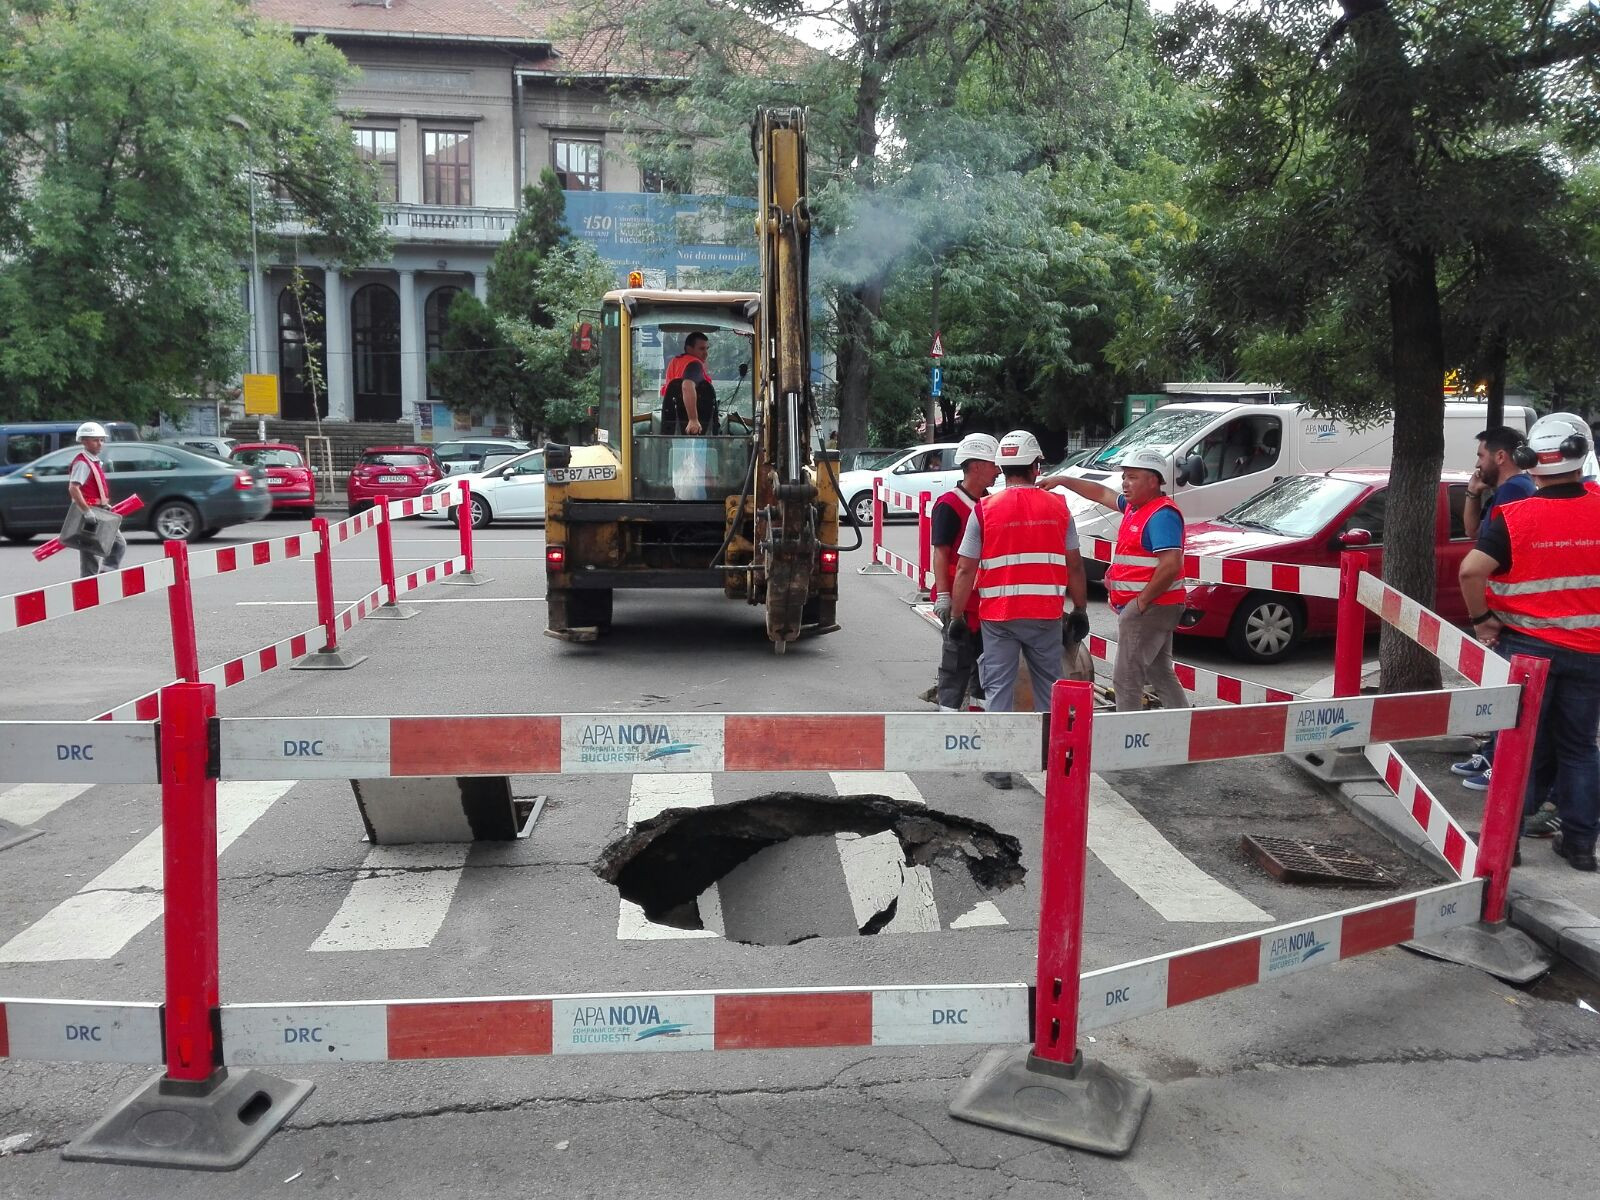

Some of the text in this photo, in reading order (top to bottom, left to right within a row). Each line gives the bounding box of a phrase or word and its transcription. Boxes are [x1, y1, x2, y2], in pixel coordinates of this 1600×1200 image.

[586, 216, 612, 230] 150
[678, 250, 693, 260] Noi
[934, 368, 940, 392] P
[1305, 424, 1336, 433] APA NOVA
[556, 468, 611, 481] B 87 APB
[1297, 707, 1345, 727] APA NOVA
[1476, 704, 1493, 716] DRC
[582, 724, 670, 744] APA NOVA
[1124, 733, 1150, 749] DRC
[283, 740, 323, 756] DRC
[945, 735, 982, 750] DRC
[57, 744, 94, 761] DRC
[1440, 902, 1457, 917] DRC
[1271, 931, 1315, 957] APA NOVA
[1106, 987, 1130, 1006] DRC
[573, 1005, 660, 1026] APA NOVA
[932, 1009, 968, 1025] DRC
[65, 1025, 102, 1041] DRC
[284, 1027, 323, 1043] DRC
